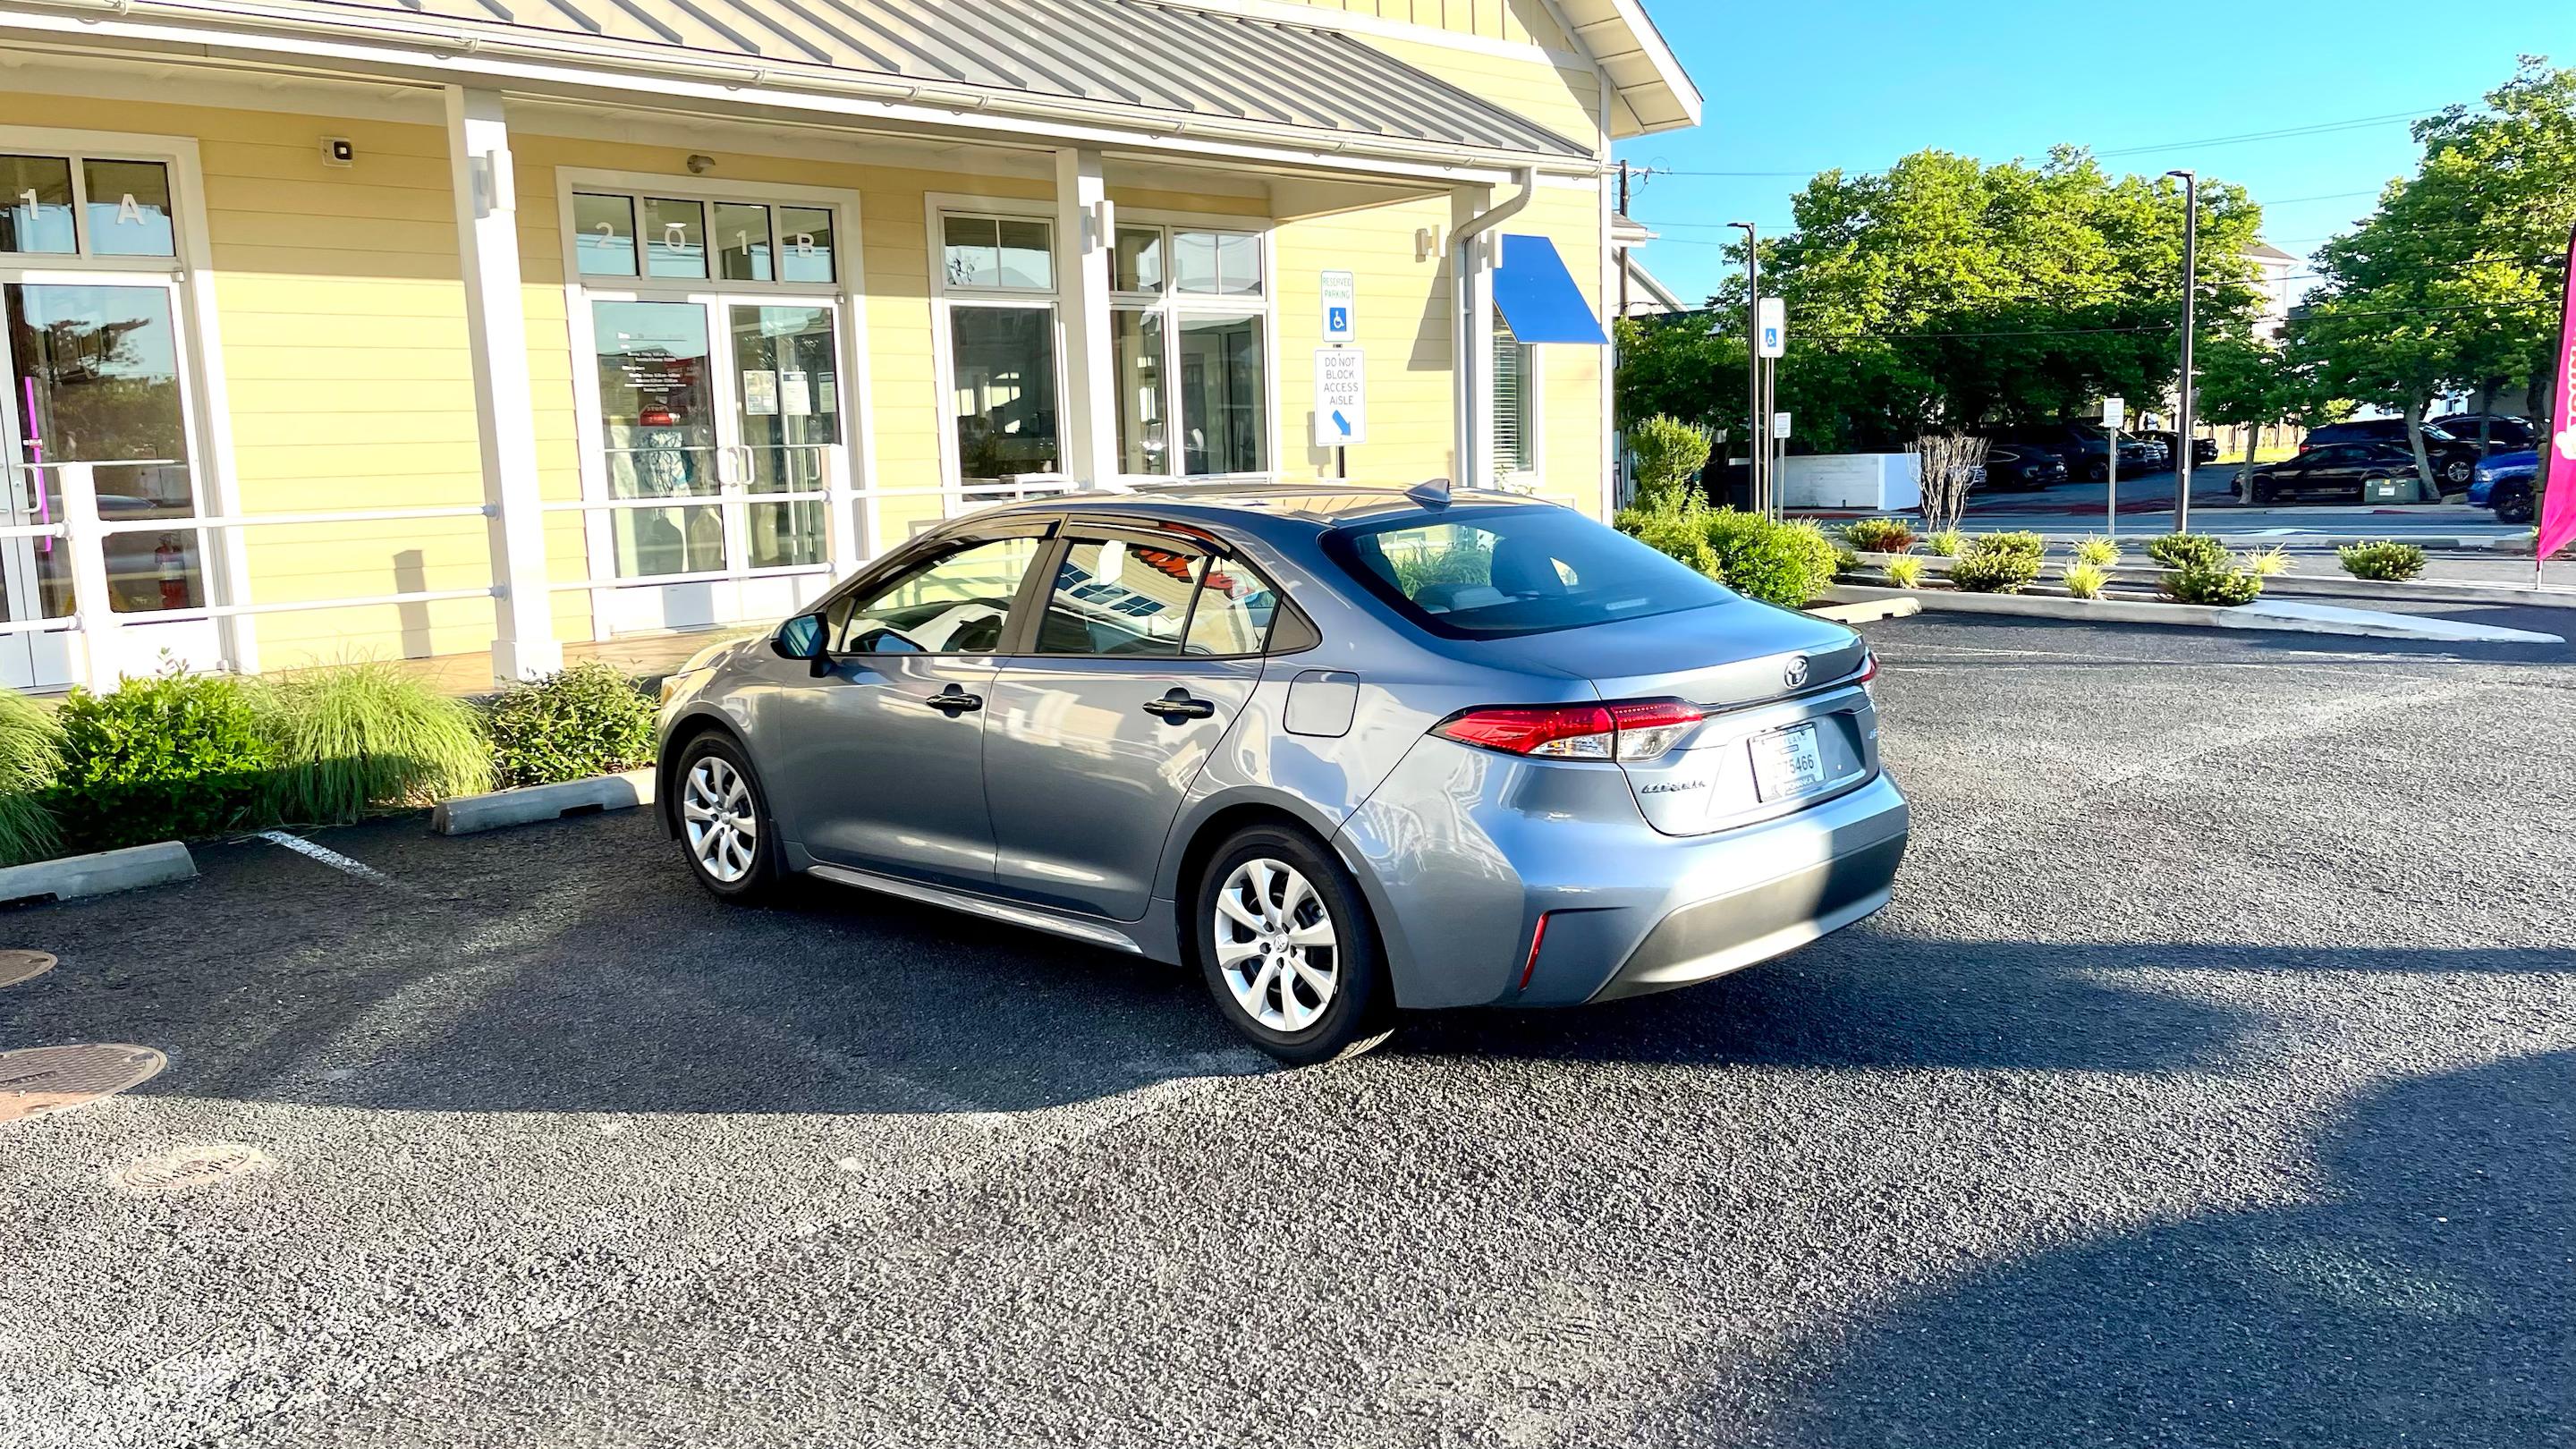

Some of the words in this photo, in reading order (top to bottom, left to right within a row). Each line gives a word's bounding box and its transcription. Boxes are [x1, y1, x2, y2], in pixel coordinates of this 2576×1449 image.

[115, 192, 147, 226] A
[1322, 276, 1352, 287] RESERVED
[1324, 289, 1351, 300] PARKING
[1325, 357, 1336, 368] DO
[1338, 357, 1356, 368] NOT
[1326, 369, 1355, 380] BLOCK
[1323, 382, 1359, 393] ACCESS
[1329, 394, 1354, 405] AISLE
